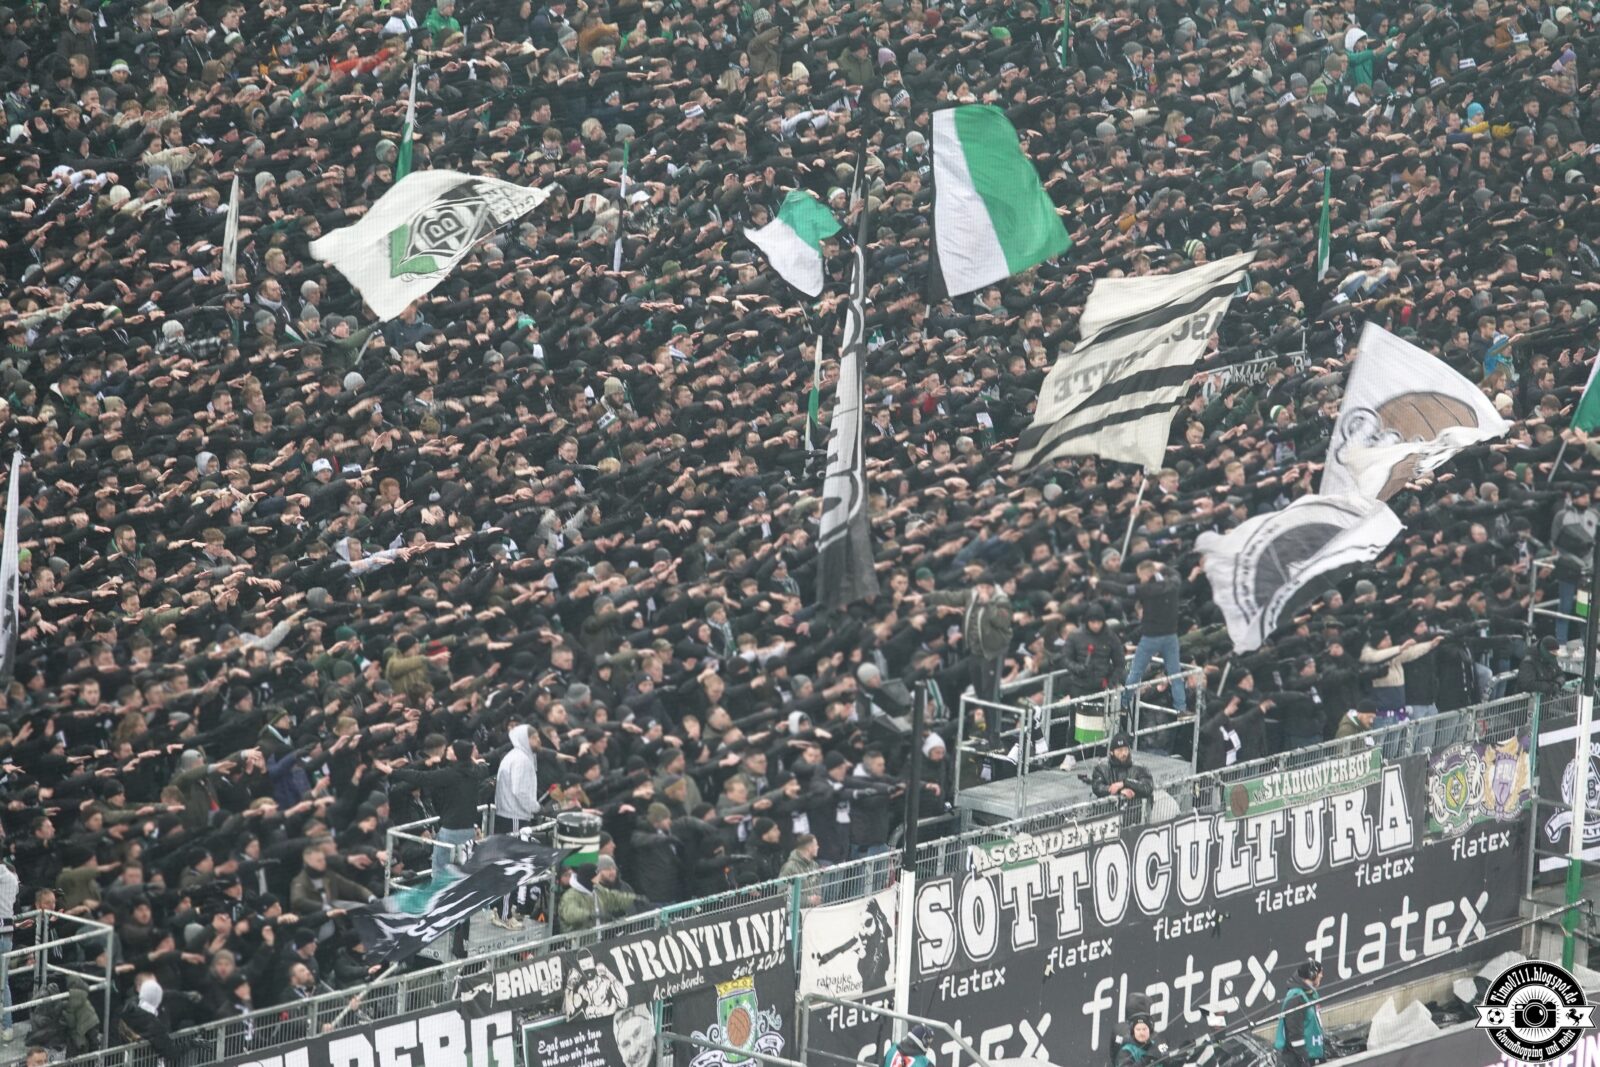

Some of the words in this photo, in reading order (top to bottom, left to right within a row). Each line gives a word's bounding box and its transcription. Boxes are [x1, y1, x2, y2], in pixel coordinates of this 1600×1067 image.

[1263, 751, 1372, 798] STADIONVERBOT
[915, 764, 1413, 974] SOTTOCULTURA
[973, 818, 1120, 873] ASCENDENTE
[609, 907, 785, 987] FRONTLINE
[732, 957, 755, 980] seit
[538, 1036, 559, 1056] Egal
